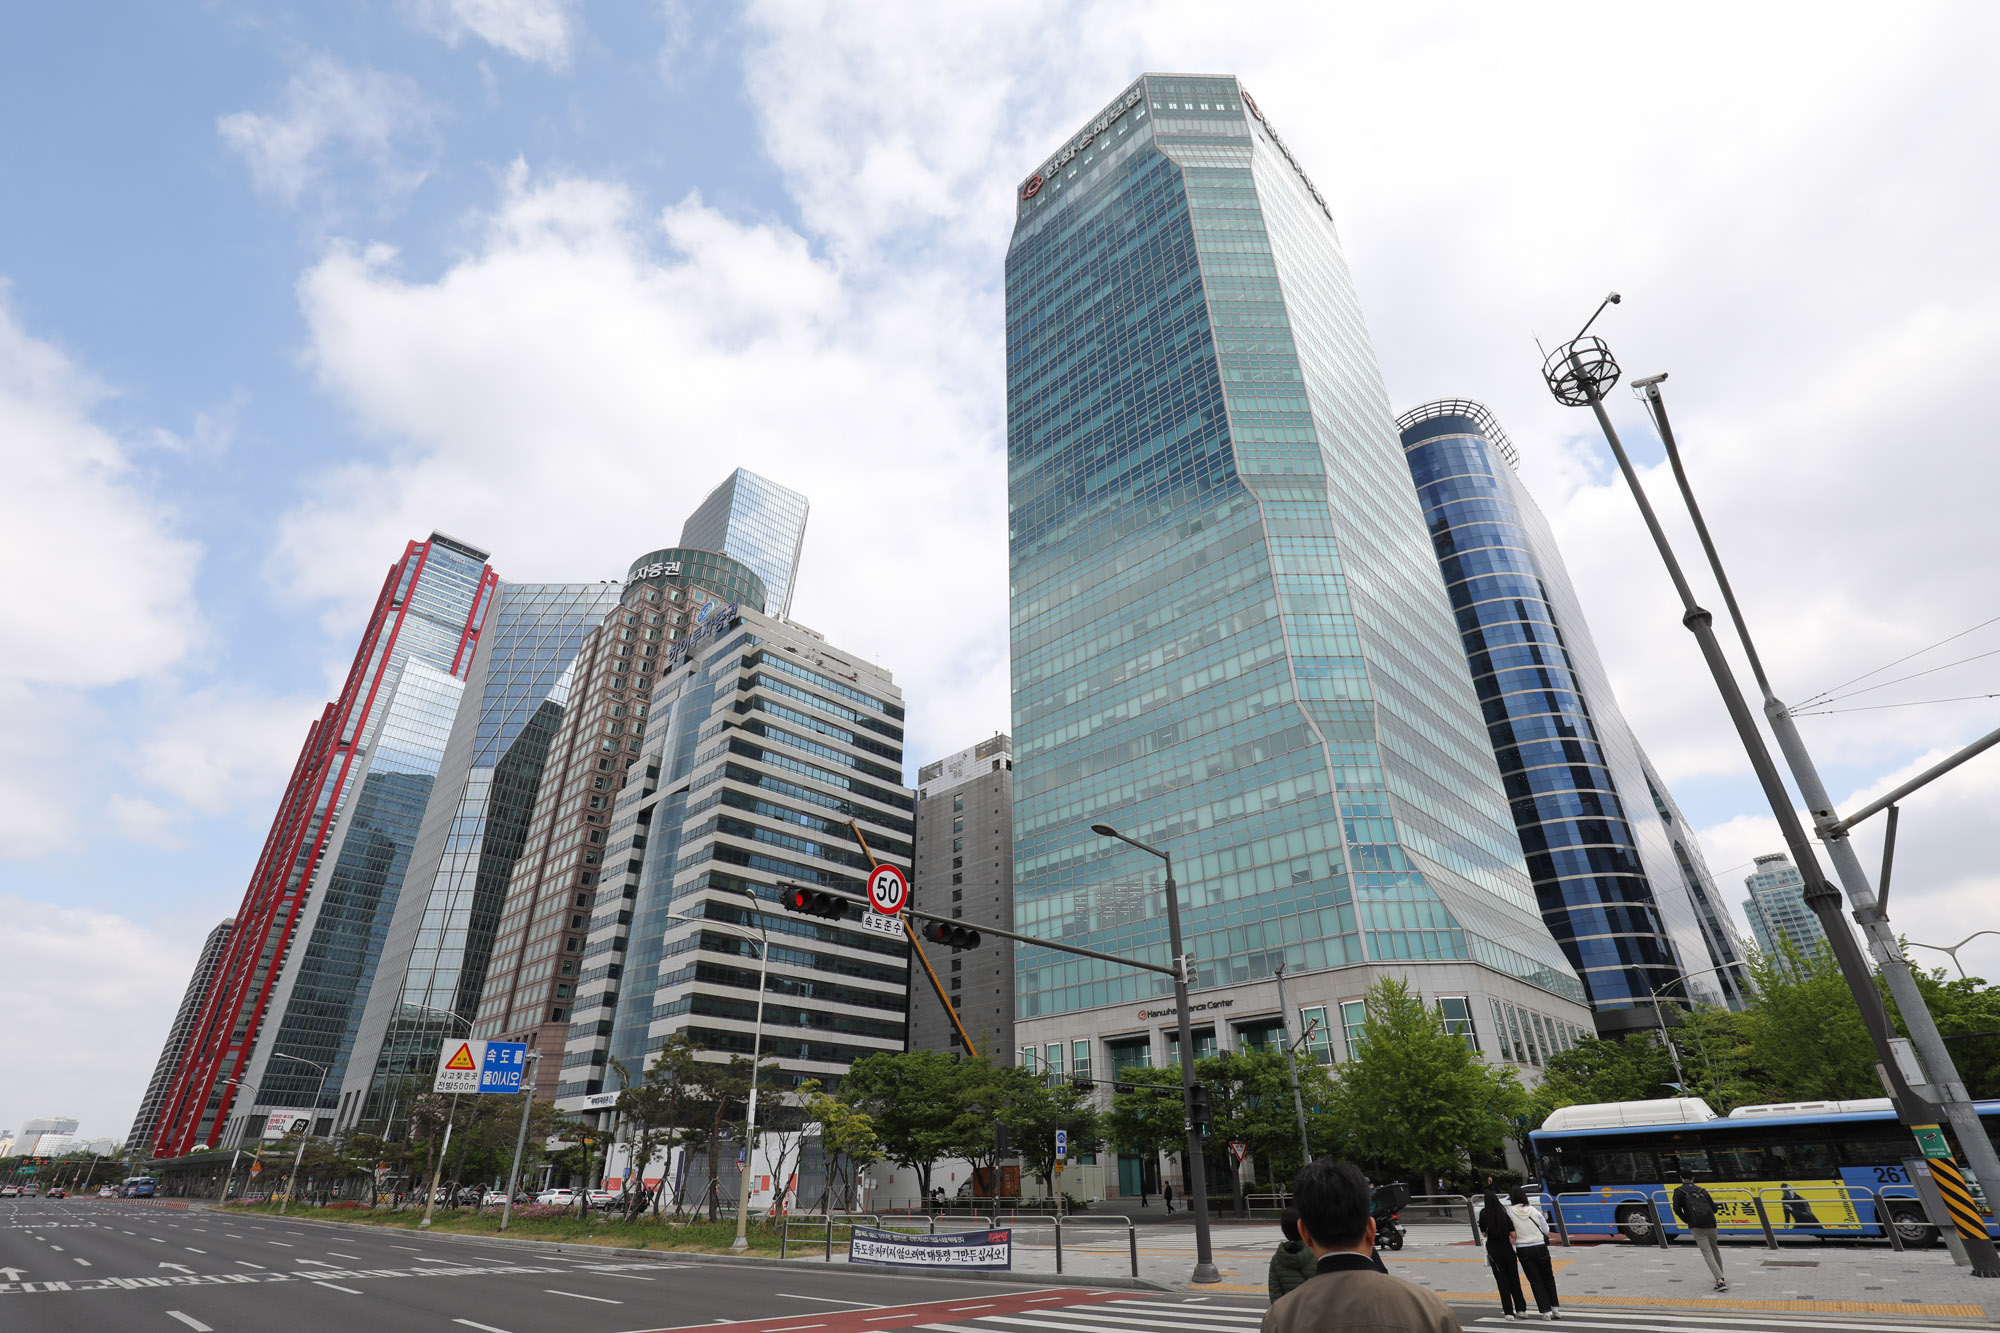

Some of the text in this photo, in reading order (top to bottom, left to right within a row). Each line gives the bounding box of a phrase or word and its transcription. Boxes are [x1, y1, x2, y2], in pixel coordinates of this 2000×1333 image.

[1045, 87, 1142, 179] 한화손해보험
[668, 600, 738, 663] 하이투자증권
[876, 877, 899, 904] 50
[865, 916, 902, 933] 속도준수
[1207, 999, 1234, 1010] Center
[486, 1048, 524, 1064] 속도를
[482, 1070, 520, 1087] 줄이시오
[1873, 1166, 1912, 1183] 261
[853, 1242, 875, 1256] 독도를
[875, 1245, 896, 1258] 지키지
[897, 1247, 927, 1261] 않으려면
[927, 1249, 951, 1262] 대통령
